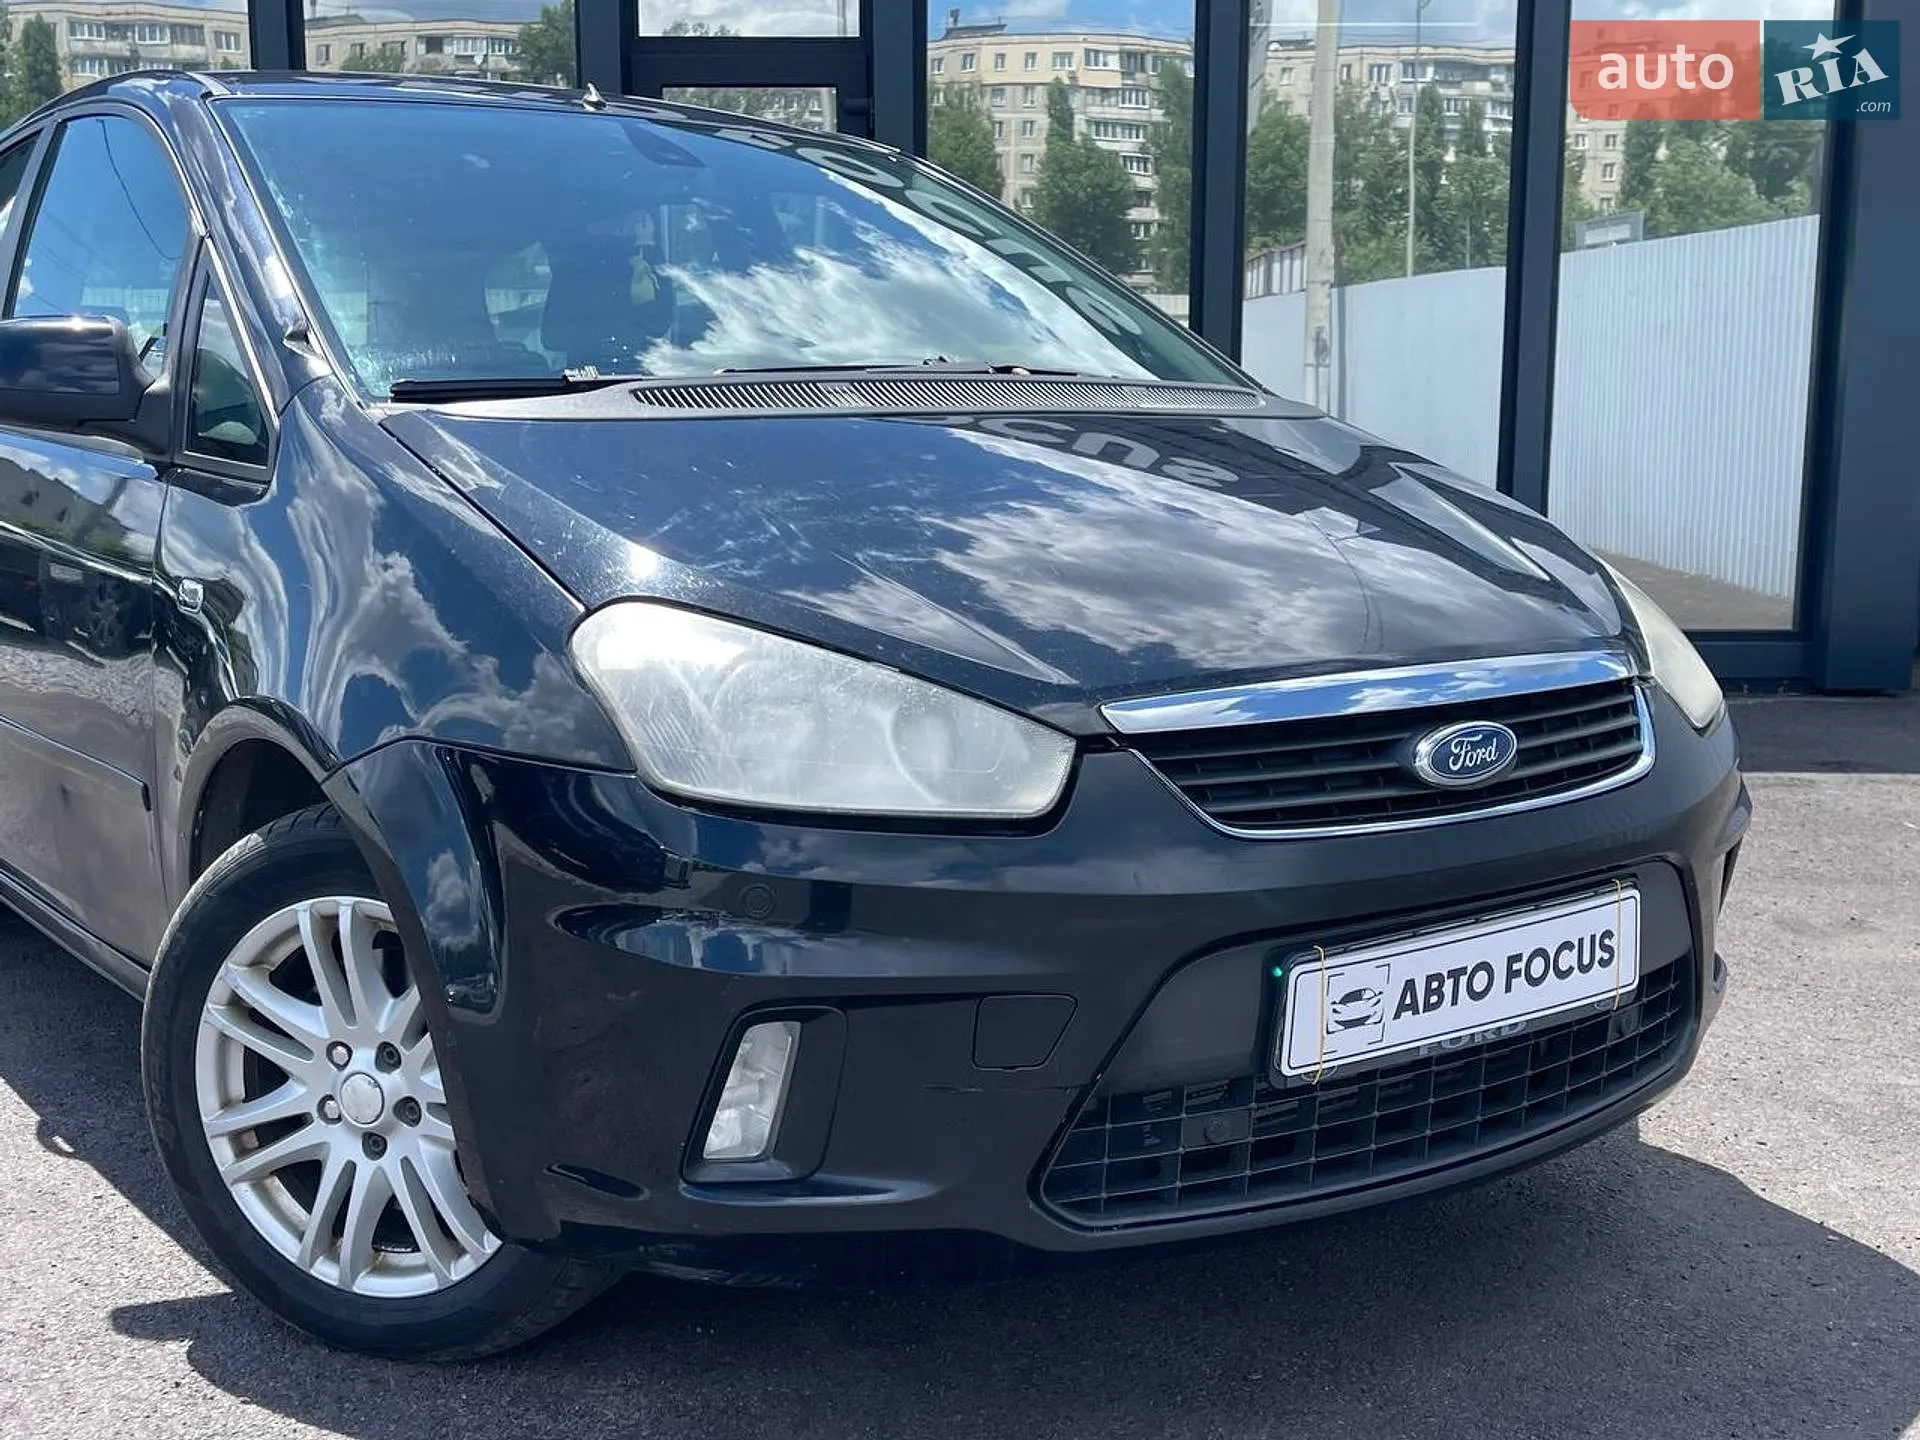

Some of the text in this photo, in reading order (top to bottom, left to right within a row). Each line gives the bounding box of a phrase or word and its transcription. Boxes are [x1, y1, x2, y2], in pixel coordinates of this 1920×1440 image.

[1448, 733, 1499, 771] Ford
[1393, 929, 1616, 1021] АВТО FOCUS
